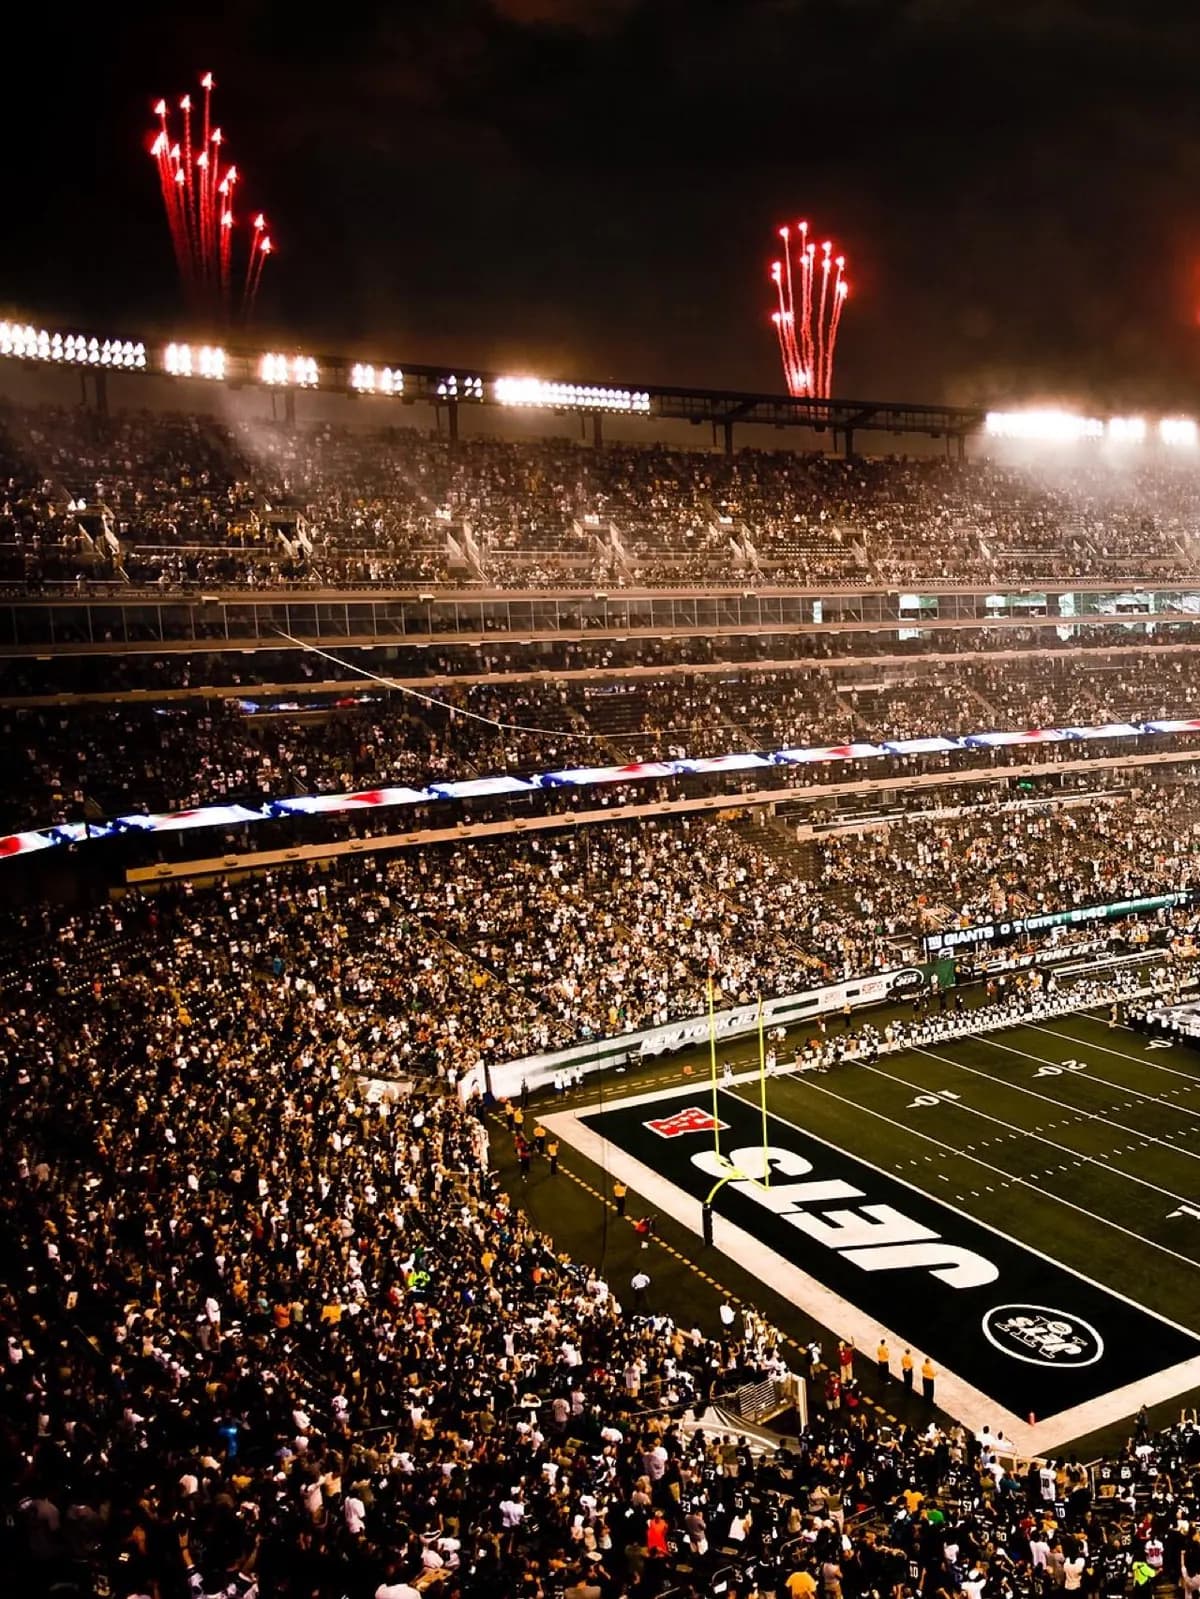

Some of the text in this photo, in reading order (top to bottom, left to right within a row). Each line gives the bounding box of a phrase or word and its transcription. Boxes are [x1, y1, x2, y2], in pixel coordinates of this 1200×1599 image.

[944, 926, 994, 946] GIANTS
[640, 1029, 683, 1051] NEW
[1038, 1060, 1087, 1077] 20
[915, 1090, 961, 1107] 10
[690, 1146, 1000, 1289] JETS
